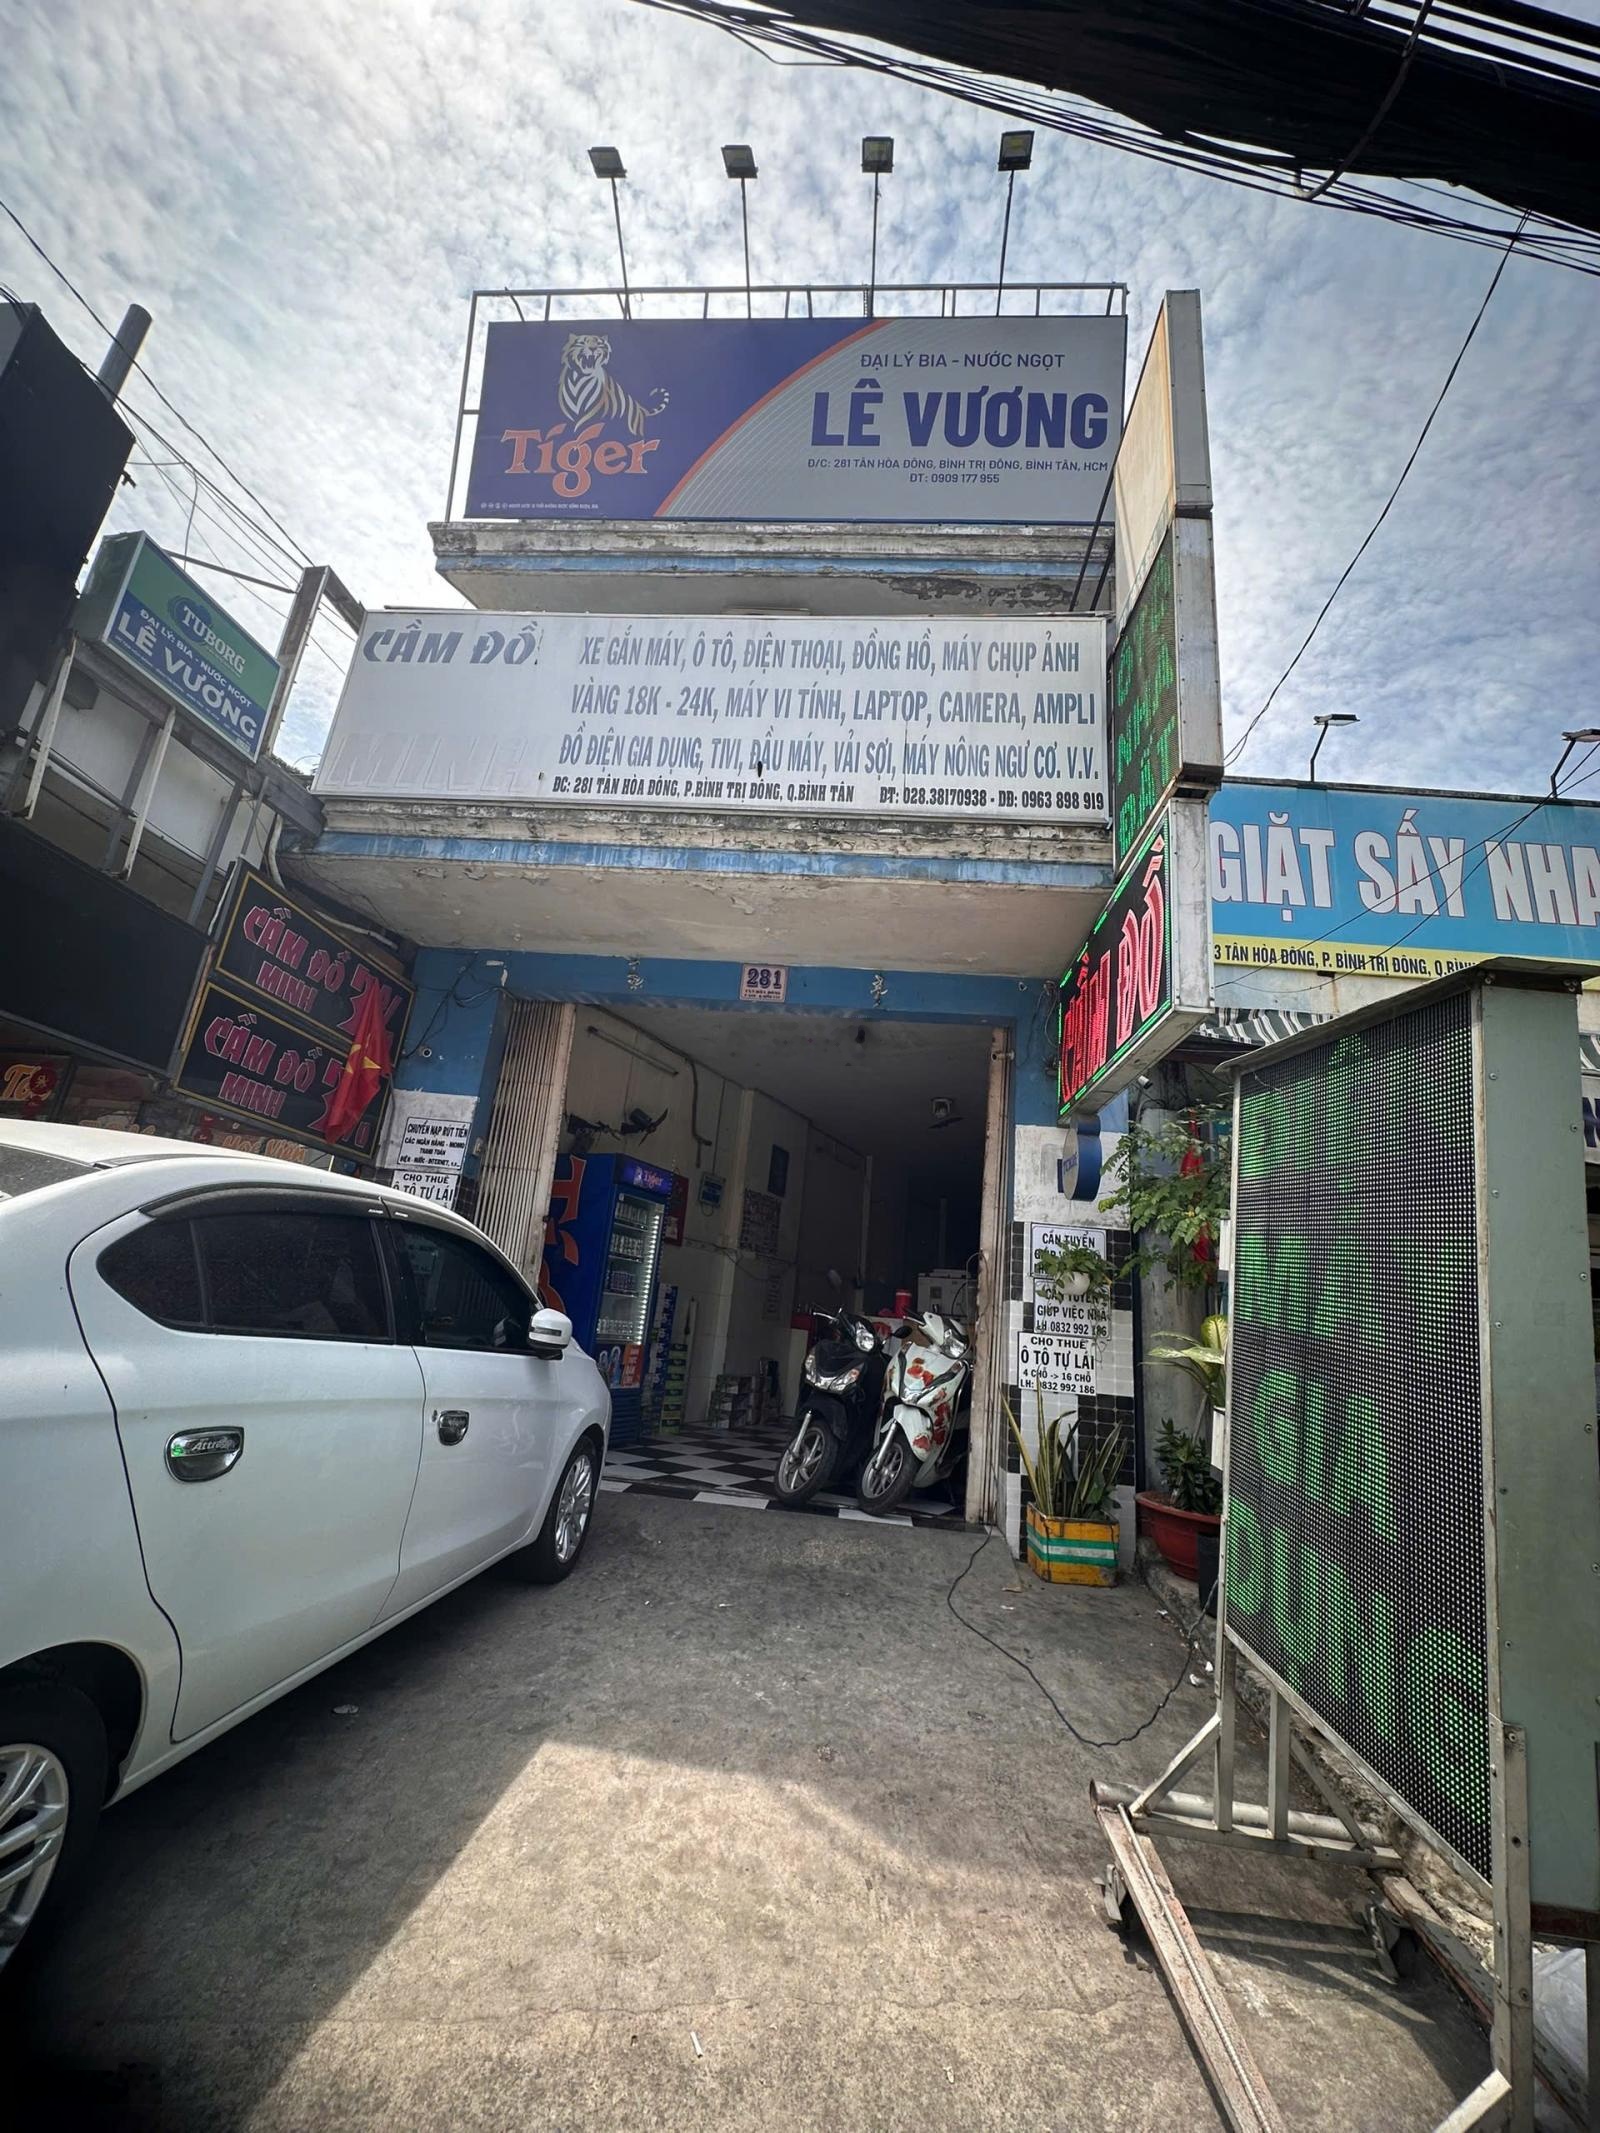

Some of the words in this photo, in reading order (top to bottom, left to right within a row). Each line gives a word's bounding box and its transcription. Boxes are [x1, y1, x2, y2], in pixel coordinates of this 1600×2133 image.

[860, 353, 888, 371] ĐẠI
[893, 351, 913, 368] LÝ
[919, 354, 947, 368] BIA
[964, 351, 1012, 368] NƯỚC
[1017, 354, 1065, 371] NGỌT
[811, 378, 884, 447] LÊ
[903, 385, 1109, 449] VƯƠNG
[501, 423, 661, 498] Tiger
[807, 458, 831, 469] Đ/C:
[834, 458, 851, 469] 281
[854, 456, 875, 469] TÂN
[877, 456, 900, 469] HÒA
[903, 456, 937, 471] ĐÔNG,
[939, 456, 967, 470] BÌNH
[968, 458, 986, 472] TRỊ
[989, 457, 1023, 472] ĐÔNG,
[1026, 458, 1053, 471] BÌNH
[1055, 458, 1081, 472] TÂN,
[1083, 460, 1108, 472] HCM
[909, 472, 929, 483] ĐT:
[931, 473, 959, 483] 0909
[961, 473, 978, 484] 177
[979, 473, 1000, 484] 955
[182, 606, 246, 674] TUBORG
[362, 618, 464, 665] CẦM
[469, 620, 539, 665] ĐỒ
[579, 636, 601, 666] XE
[605, 624, 642, 666] GẮN
[645, 630, 686, 673] MÁY,
[692, 631, 708, 668] Ô
[711, 631, 737, 673] TÔ,
[743, 632, 784, 676] ĐIỆN
[790, 638, 846, 675] THOẠI,
[852, 628, 901, 671] ĐỒNG
[905, 629, 937, 676] HỒ,
[942, 633, 982, 672] MÁY
[987, 641, 1037, 678] CHỤP
[1041, 631, 1079, 672] ẢNH
[117, 611, 157, 657] LÊ
[163, 646, 257, 739] VƯƠNG
[176, 639, 193, 659] BIA
[200, 661, 227, 687] NƯỚC
[228, 684, 252, 707] NGỌT
[570, 676, 620, 715] VÀNG
[624, 685, 662, 716] 18K
[676, 685, 718, 723] 24K,
[725, 681, 769, 718] MÁY
[773, 688, 792, 718] VI
[798, 682, 846, 726] TÍNH,
[853, 690, 932, 728] LAPTOP,
[939, 691, 1026, 731] CAMERA,
[1033, 692, 1095, 725] AMPLI
[559, 721, 587, 765] ĐỒ
[585, 727, 626, 772] ĐIỆN
[627, 736, 653, 767] GIA
[657, 737, 704, 774] DỤNG,
[711, 737, 744, 776] TIVI,
[748, 725, 783, 772] ĐẦU
[788, 732, 827, 779] MÁY,
[834, 729, 861, 773] VẢI
[865, 736, 896, 781] SỢI,
[902, 735, 939, 776] MÁY
[944, 740, 992, 779] NÔNG
[995, 740, 1030, 779] NGƯ
[1033, 741, 1060, 780] CƠ.
[1066, 747, 1099, 780] V.V.
[552, 776, 571, 793] ĐC:
[597, 774, 620, 795] TÂN
[622, 774, 645, 795] HÒA
[648, 776, 680, 798] ĐÔNG,
[684, 777, 723, 801] P.BÌNH
[726, 781, 747, 804] TRỊ
[748, 780, 782, 803] ĐÔNG,
[787, 780, 826, 803] Q.BÌNH
[829, 781, 854, 803] TÂN
[880, 785, 899, 804] ĐT:
[902, 785, 987, 807] 028.38170938
[1021, 790, 1054, 809] 0963
[1056, 791, 1080, 810] 898
[1083, 792, 1104, 811] 919
[1209, 811, 1336, 922] GIẶT
[1353, 808, 1467, 919] SẤY
[243, 905, 311, 968] CẦM
[307, 951, 351, 993] ĐỒ
[1062, 951, 1111, 1104] CẦM
[1116, 834, 1165, 1050] ĐỒ
[1224, 943, 1250, 962] TÂN
[1252, 944, 1277, 964] HÒA
[1281, 946, 1319, 968] ĐÔNG,
[1323, 951, 1333, 968] P.
[1336, 949, 1366, 970] BÌNH
[1369, 954, 1389, 976] TRỊ
[1392, 954, 1432, 977] ĐÔNG,
[256, 960, 318, 1014] MINH
[746, 968, 782, 990] 281
[204, 1013, 277, 1075] CẦM
[274, 1047, 323, 1094] ĐỒ
[218, 1071, 288, 1119] MINH
[403, 1173, 422, 1182] CHO
[435, 1185, 453, 1201] LÁI
[1050, 1321, 1071, 1333] 0832
[1073, 1323, 1089, 1335] 992
[1062, 1307, 1085, 1322] VIỆC
[1021, 1345, 1029, 1364] Ô
[1033, 1347, 1049, 1366] TÔ
[1053, 1351, 1070, 1371] TỰ
[1075, 1351, 1094, 1370] LÁI
[1031, 1336, 1053, 1347] CHO
[1020, 1379, 1034, 1389] LH:
[1060, 1382, 1076, 1392] 992
[1079, 1384, 1095, 1395] 186
[1023, 1368, 1028, 1377] 4
[1062, 1372, 1072, 1381] 16
[1253, 1369, 1398, 1542] GIA
